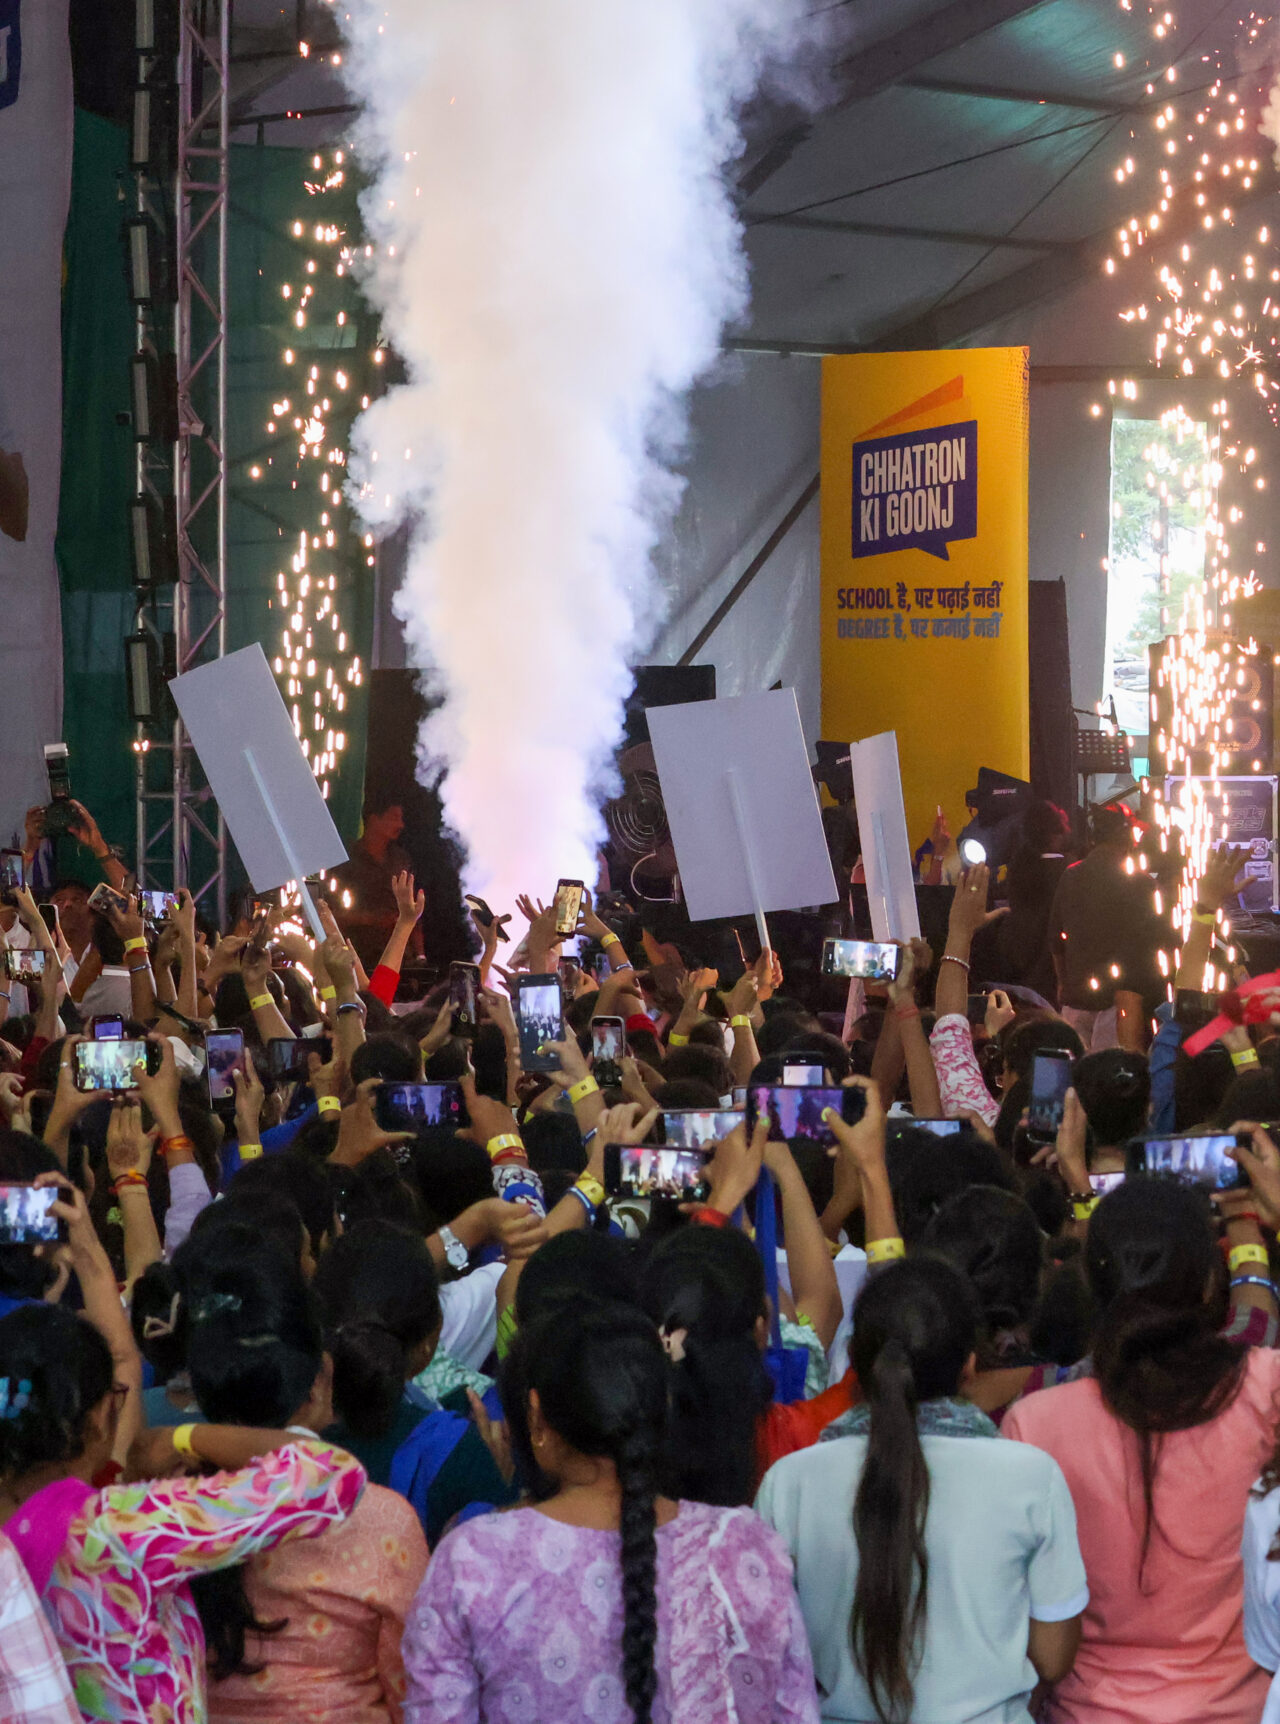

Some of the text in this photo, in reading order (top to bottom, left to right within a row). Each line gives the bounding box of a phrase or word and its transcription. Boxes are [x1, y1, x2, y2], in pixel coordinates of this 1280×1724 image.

[860, 437, 966, 496] CHHATRON
[860, 484, 954, 543] KI GOONJ
[837, 588, 894, 609] SCHOOL
[914, 588, 933, 609] पर
[972, 580, 1003, 609] नहीं
[837, 617, 890, 639] DEGREE
[910, 618, 929, 639] पर
[972, 612, 1003, 638] नहीं
